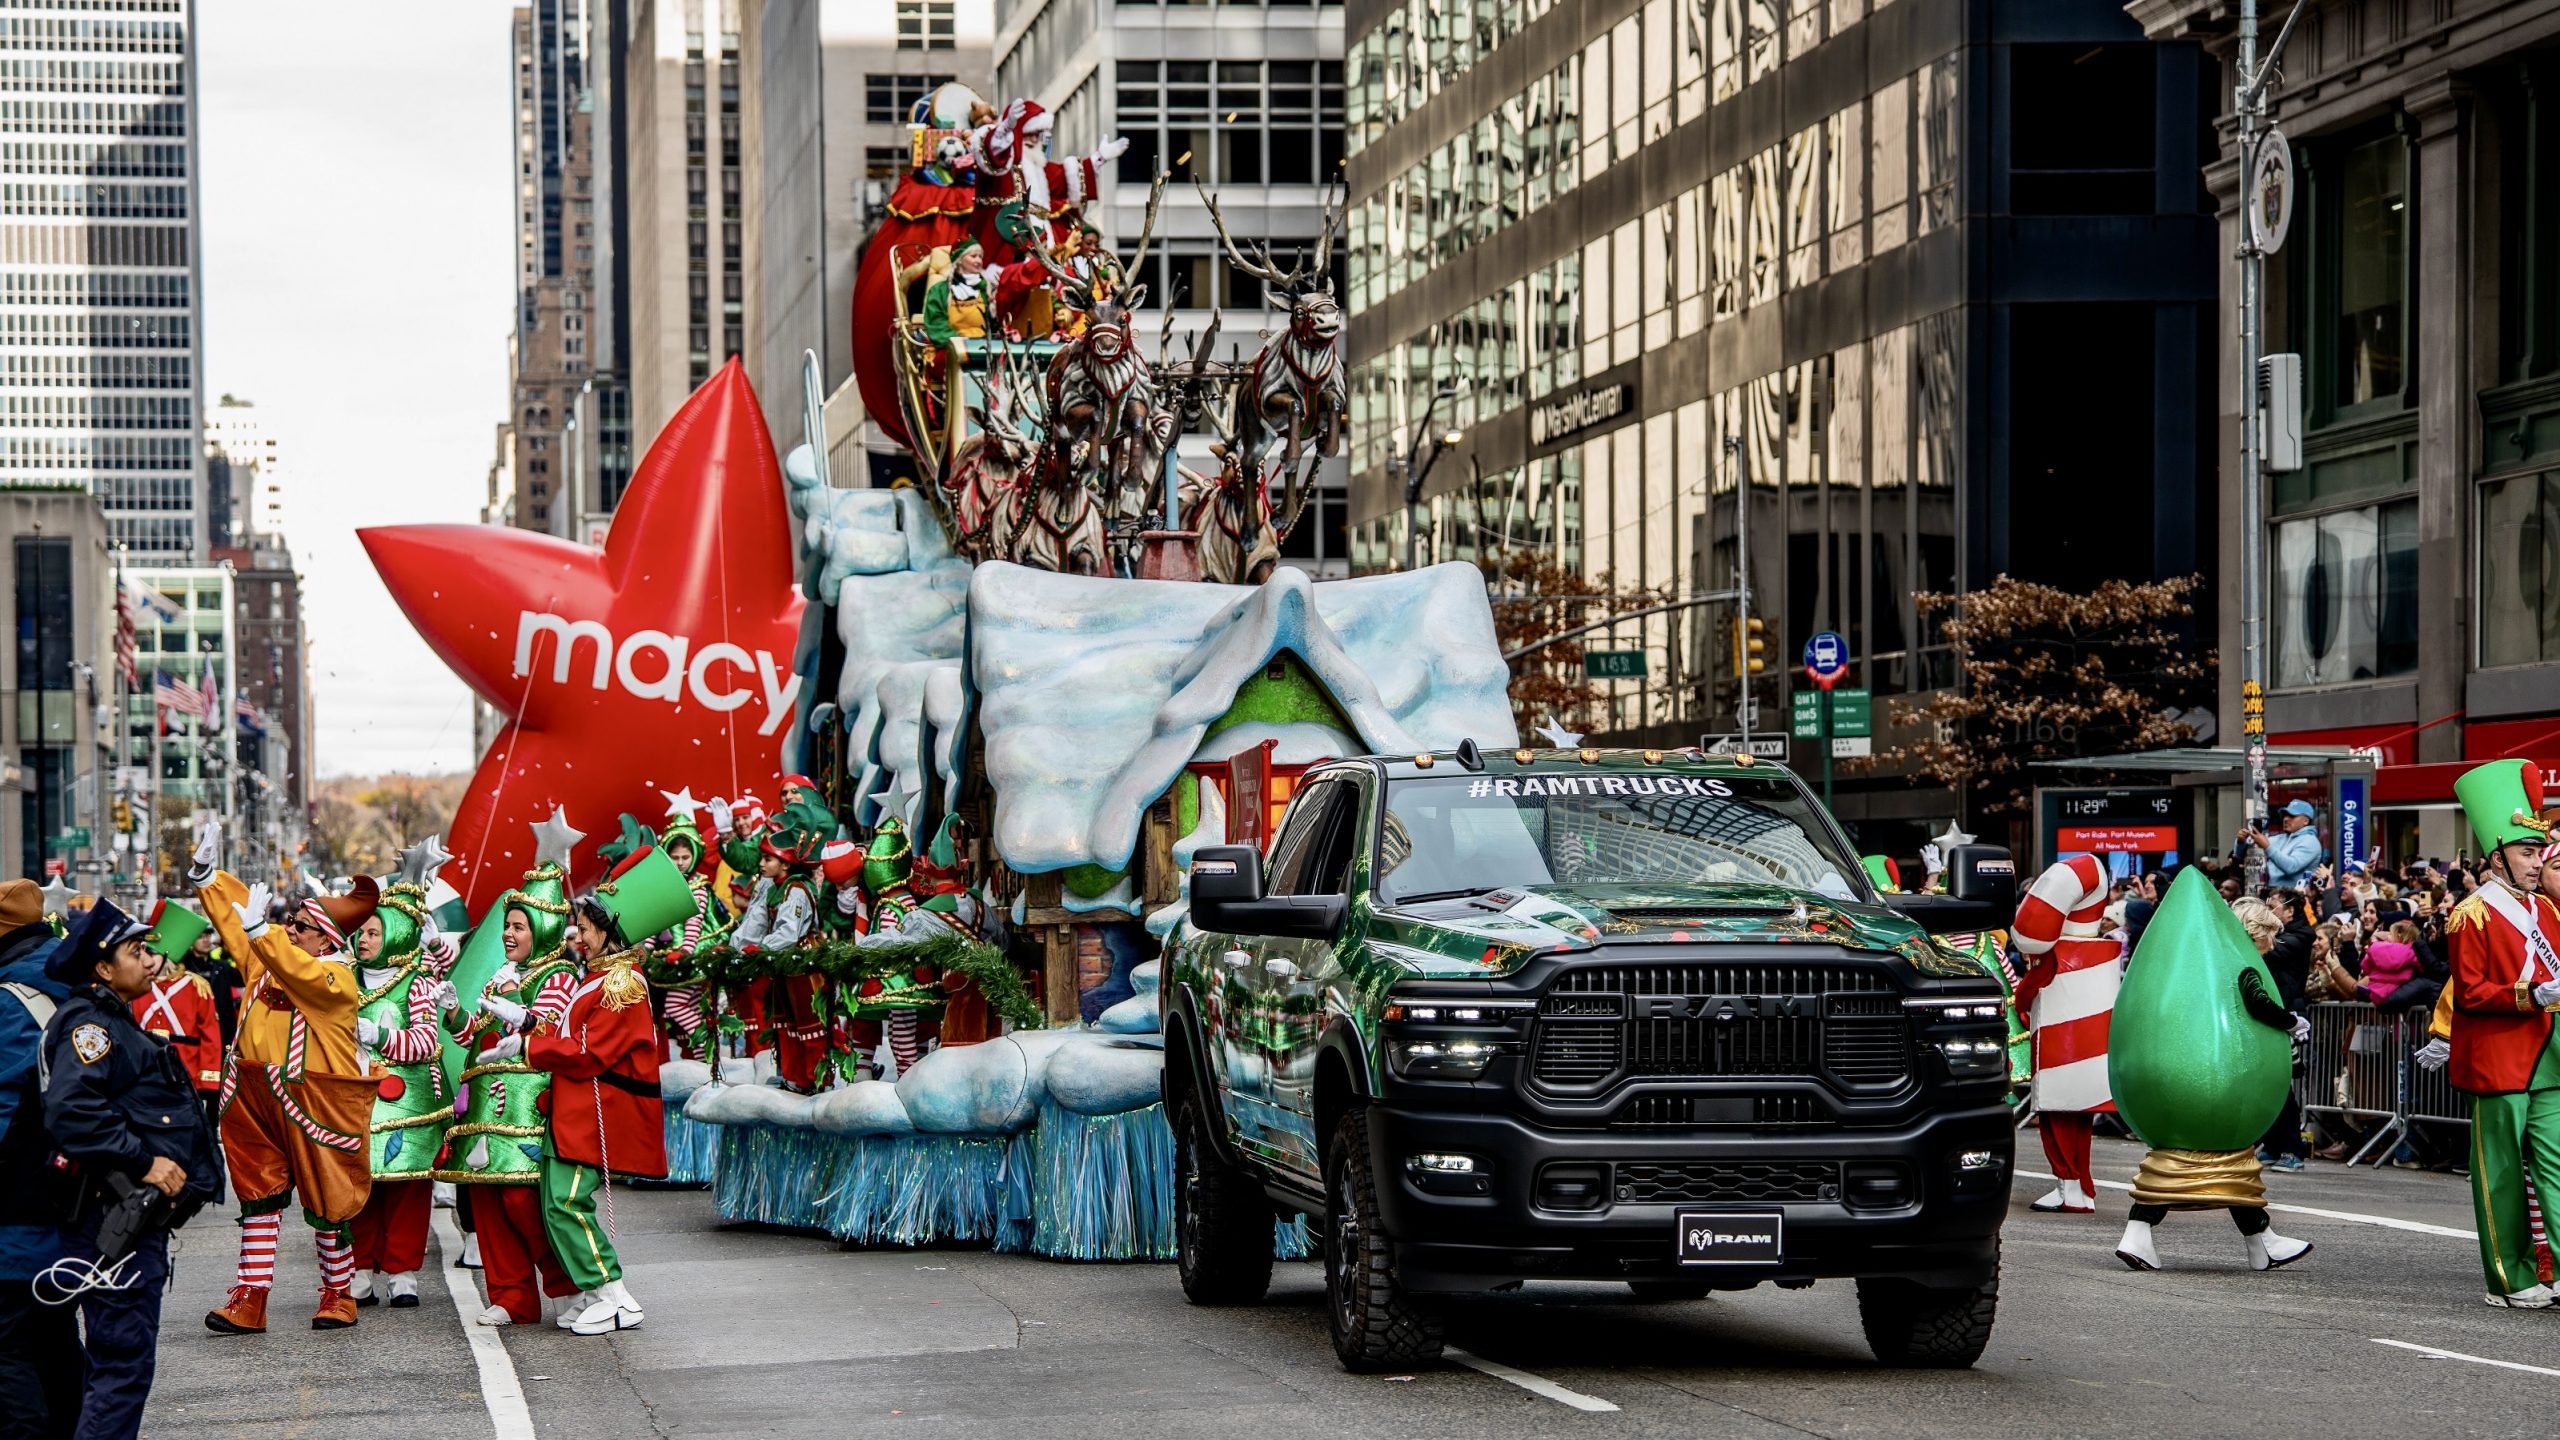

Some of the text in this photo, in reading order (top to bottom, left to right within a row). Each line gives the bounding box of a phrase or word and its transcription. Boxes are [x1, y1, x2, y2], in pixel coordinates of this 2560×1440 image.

[1795, 693, 1816, 705] QM1
[1795, 708, 1817, 721] QM5
[1795, 723, 1817, 736] QM6
[1719, 742, 1778, 755] ONE WAY
[1467, 777, 1734, 798] #RAMTRUCKS
[2344, 799, 2358, 868] 6 Avenue
[2531, 929, 2560, 973] CAPTAIN
[1633, 994, 1817, 1018] RAM
[1714, 1234, 1771, 1243] RAM
